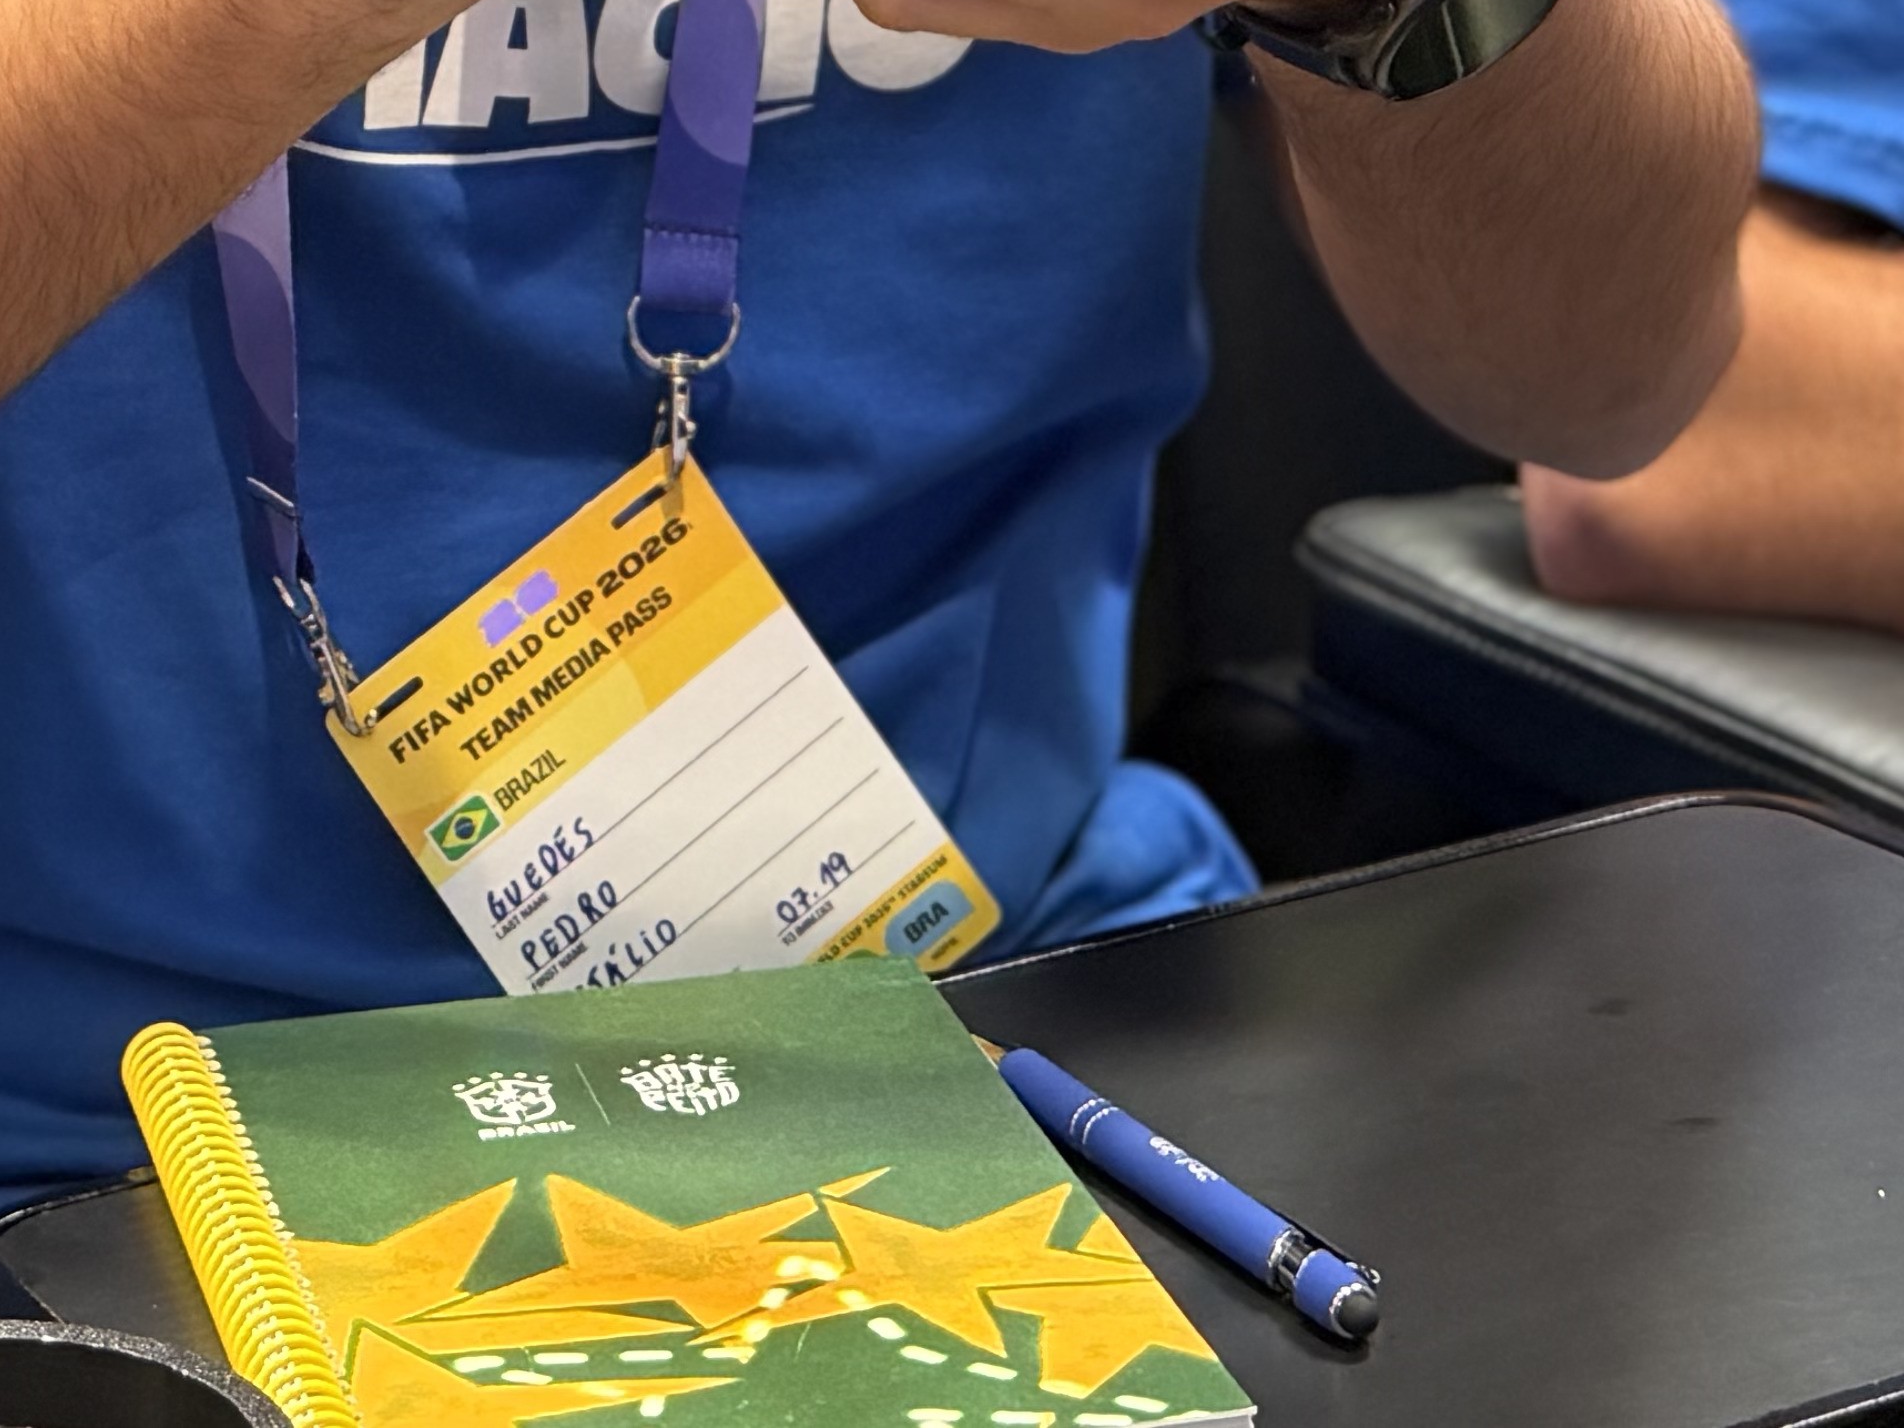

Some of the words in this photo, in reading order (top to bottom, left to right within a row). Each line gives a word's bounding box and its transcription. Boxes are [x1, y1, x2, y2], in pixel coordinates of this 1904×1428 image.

[388, 709, 452, 764] FIFA
[446, 633, 543, 714] WORLD
[543, 589, 594, 639] CUP
[459, 697, 535, 761] TEAM
[530, 638, 611, 707] MEDIA
[606, 585, 673, 647] PASS
[494, 749, 566, 812] BRAZIL
[521, 880, 617, 972] PEDRO
[902, 901, 949, 943] BRA
